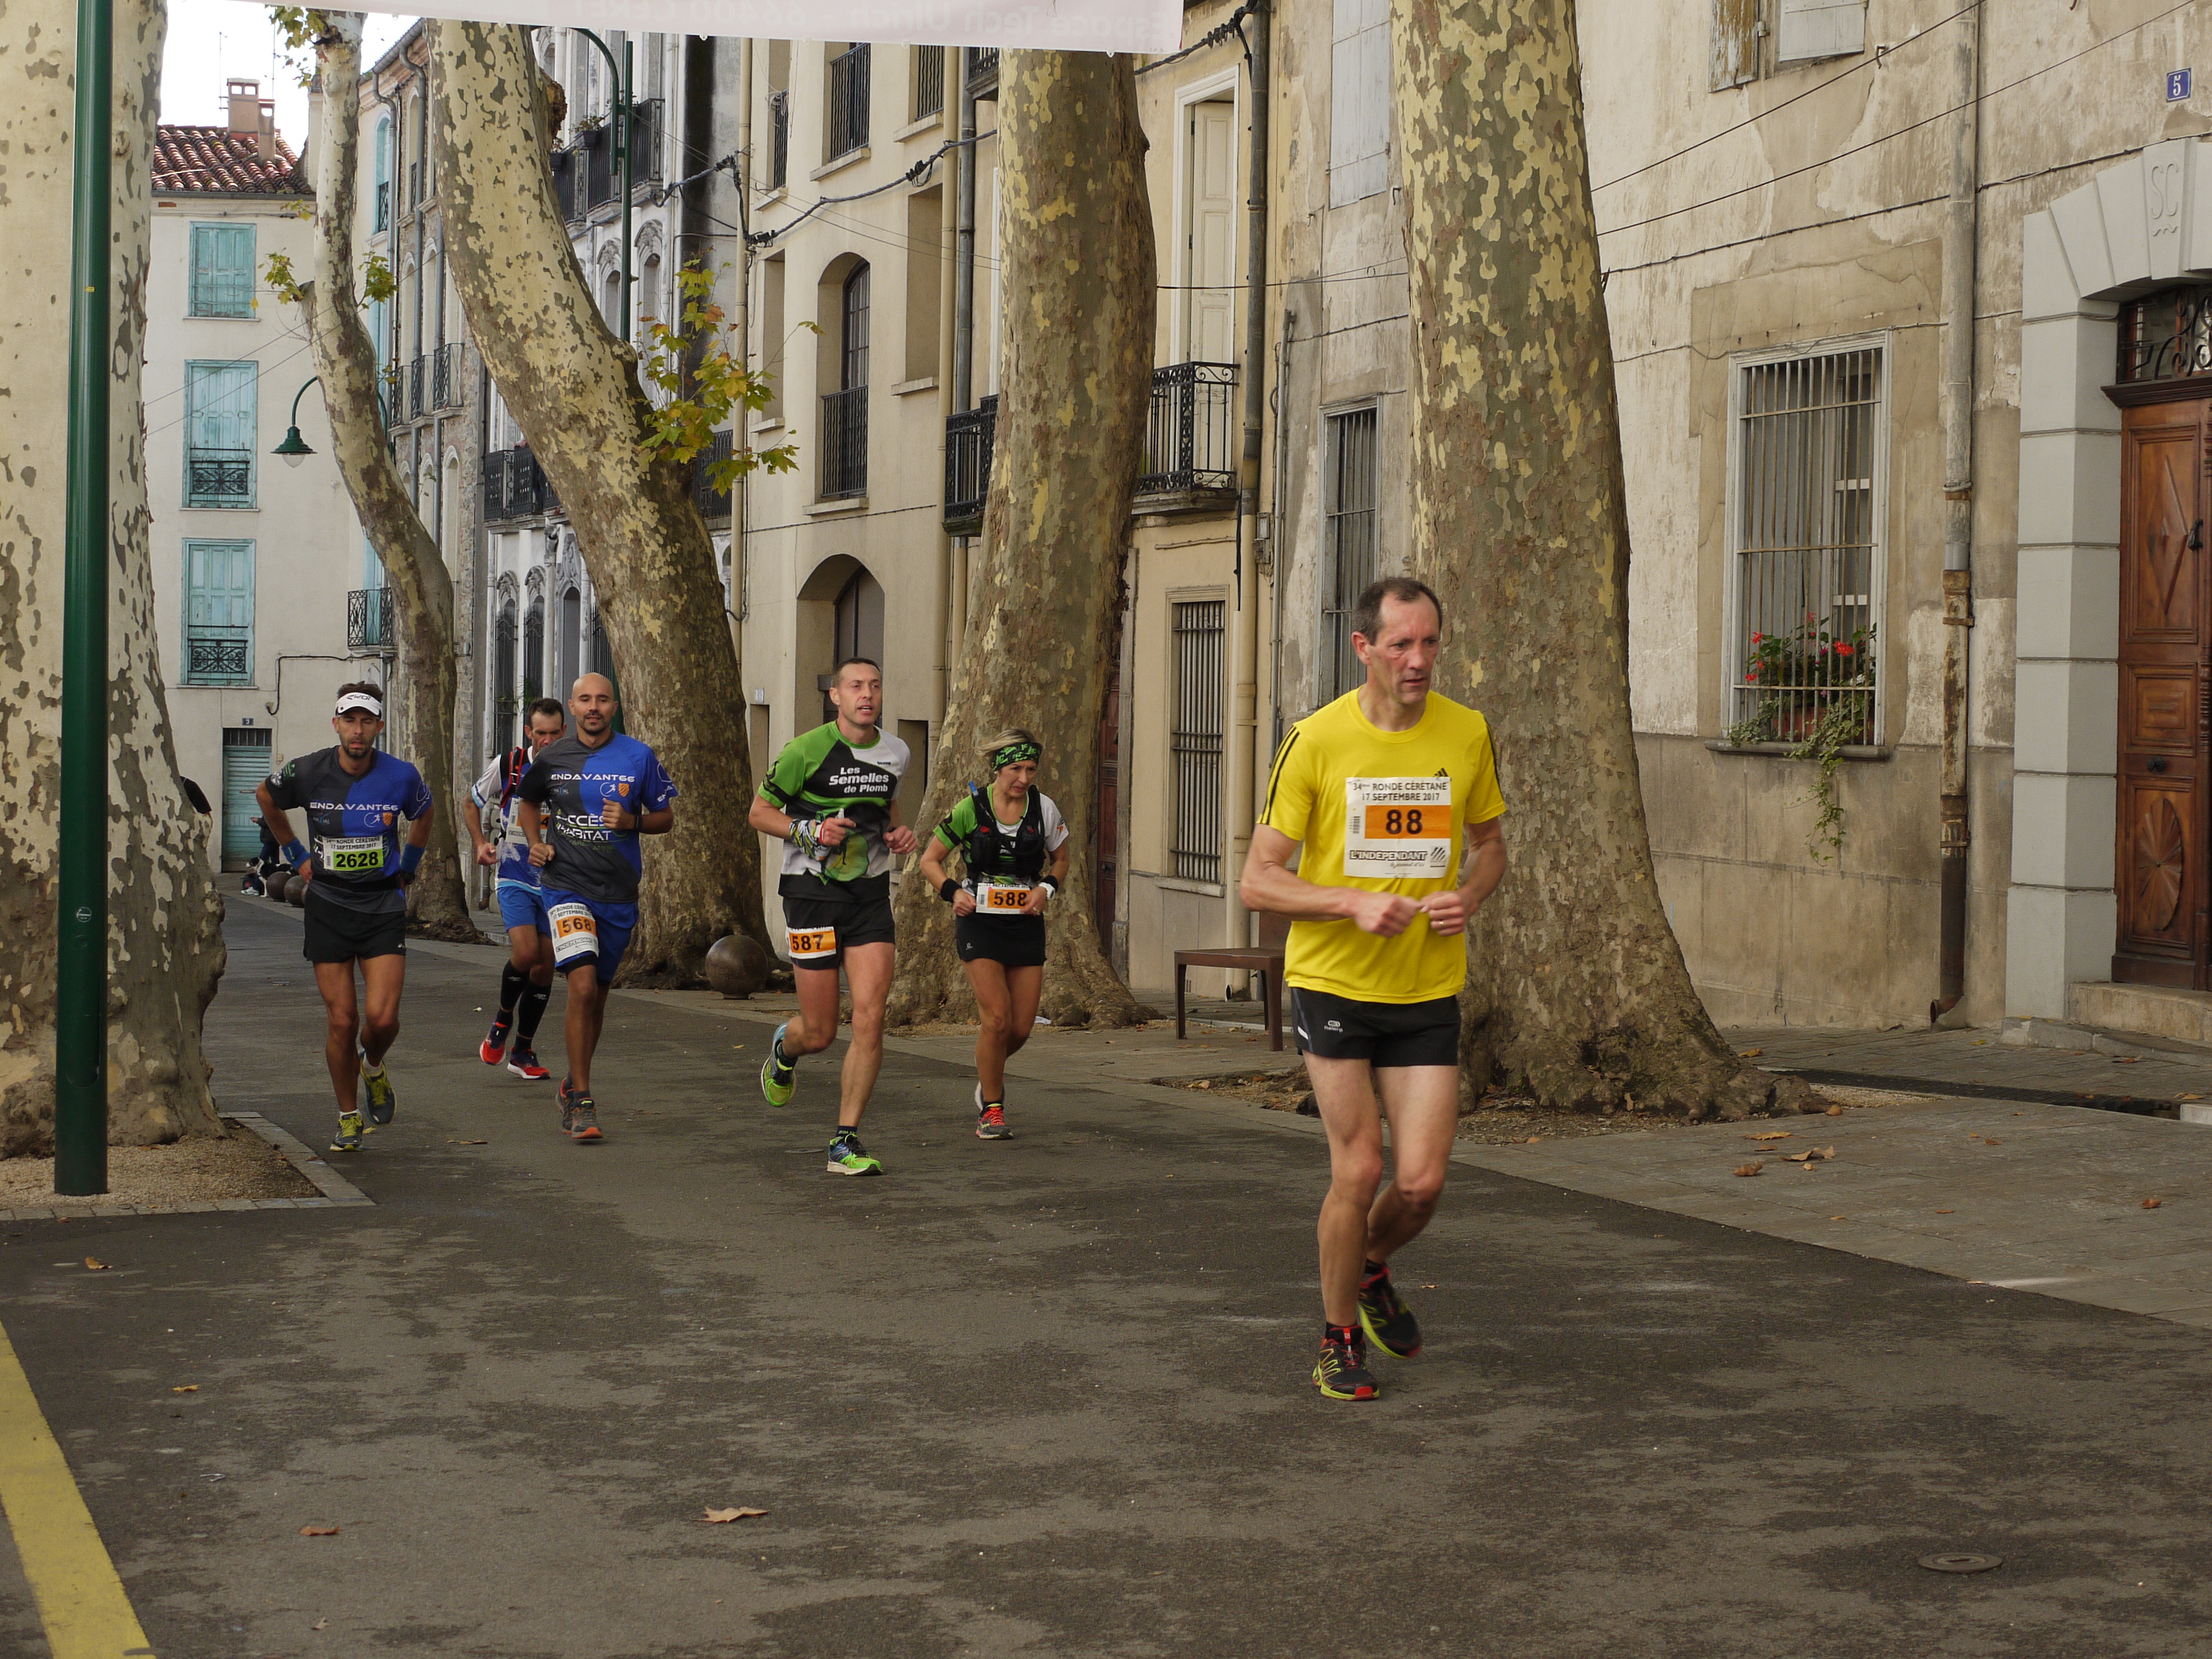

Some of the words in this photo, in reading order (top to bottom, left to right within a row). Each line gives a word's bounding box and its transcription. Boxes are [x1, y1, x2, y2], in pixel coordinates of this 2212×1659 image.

[2173, 74, 2181, 96] 5
[550, 774, 635, 782] ENDAVANT66
[829, 773, 889, 785] Semelles
[844, 785, 857, 794] de
[859, 784, 888, 792] Plomb
[1373, 782, 1402, 791] RONDE
[1405, 781, 1447, 790] CÉRÉTANE
[310, 802, 399, 811] ENDAVANT66
[1386, 809, 1423, 835] 88
[336, 852, 379, 868] 2628
[994, 891, 1027, 906] 588
[562, 918, 592, 933] 568
[792, 934, 823, 951] 587
